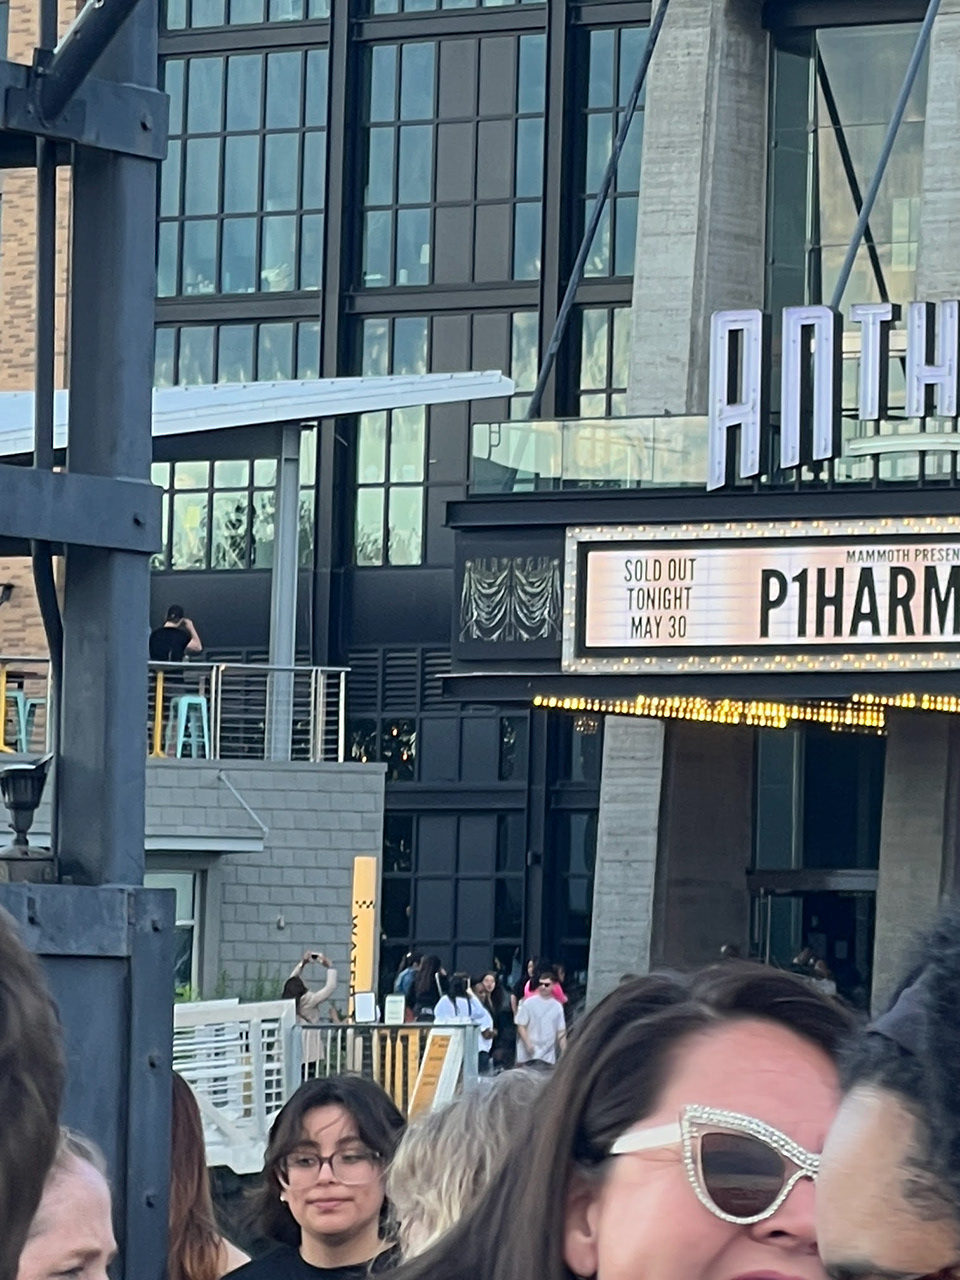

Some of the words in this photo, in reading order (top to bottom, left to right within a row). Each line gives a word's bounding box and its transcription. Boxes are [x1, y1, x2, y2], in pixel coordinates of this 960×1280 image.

[846, 548, 910, 563] MAMMOTH
[624, 559, 662, 582] SOLD
[668, 558, 697, 581] OUT
[626, 586, 692, 610] TONIGHT
[630, 616, 663, 639] MAY
[668, 615, 687, 638] 30
